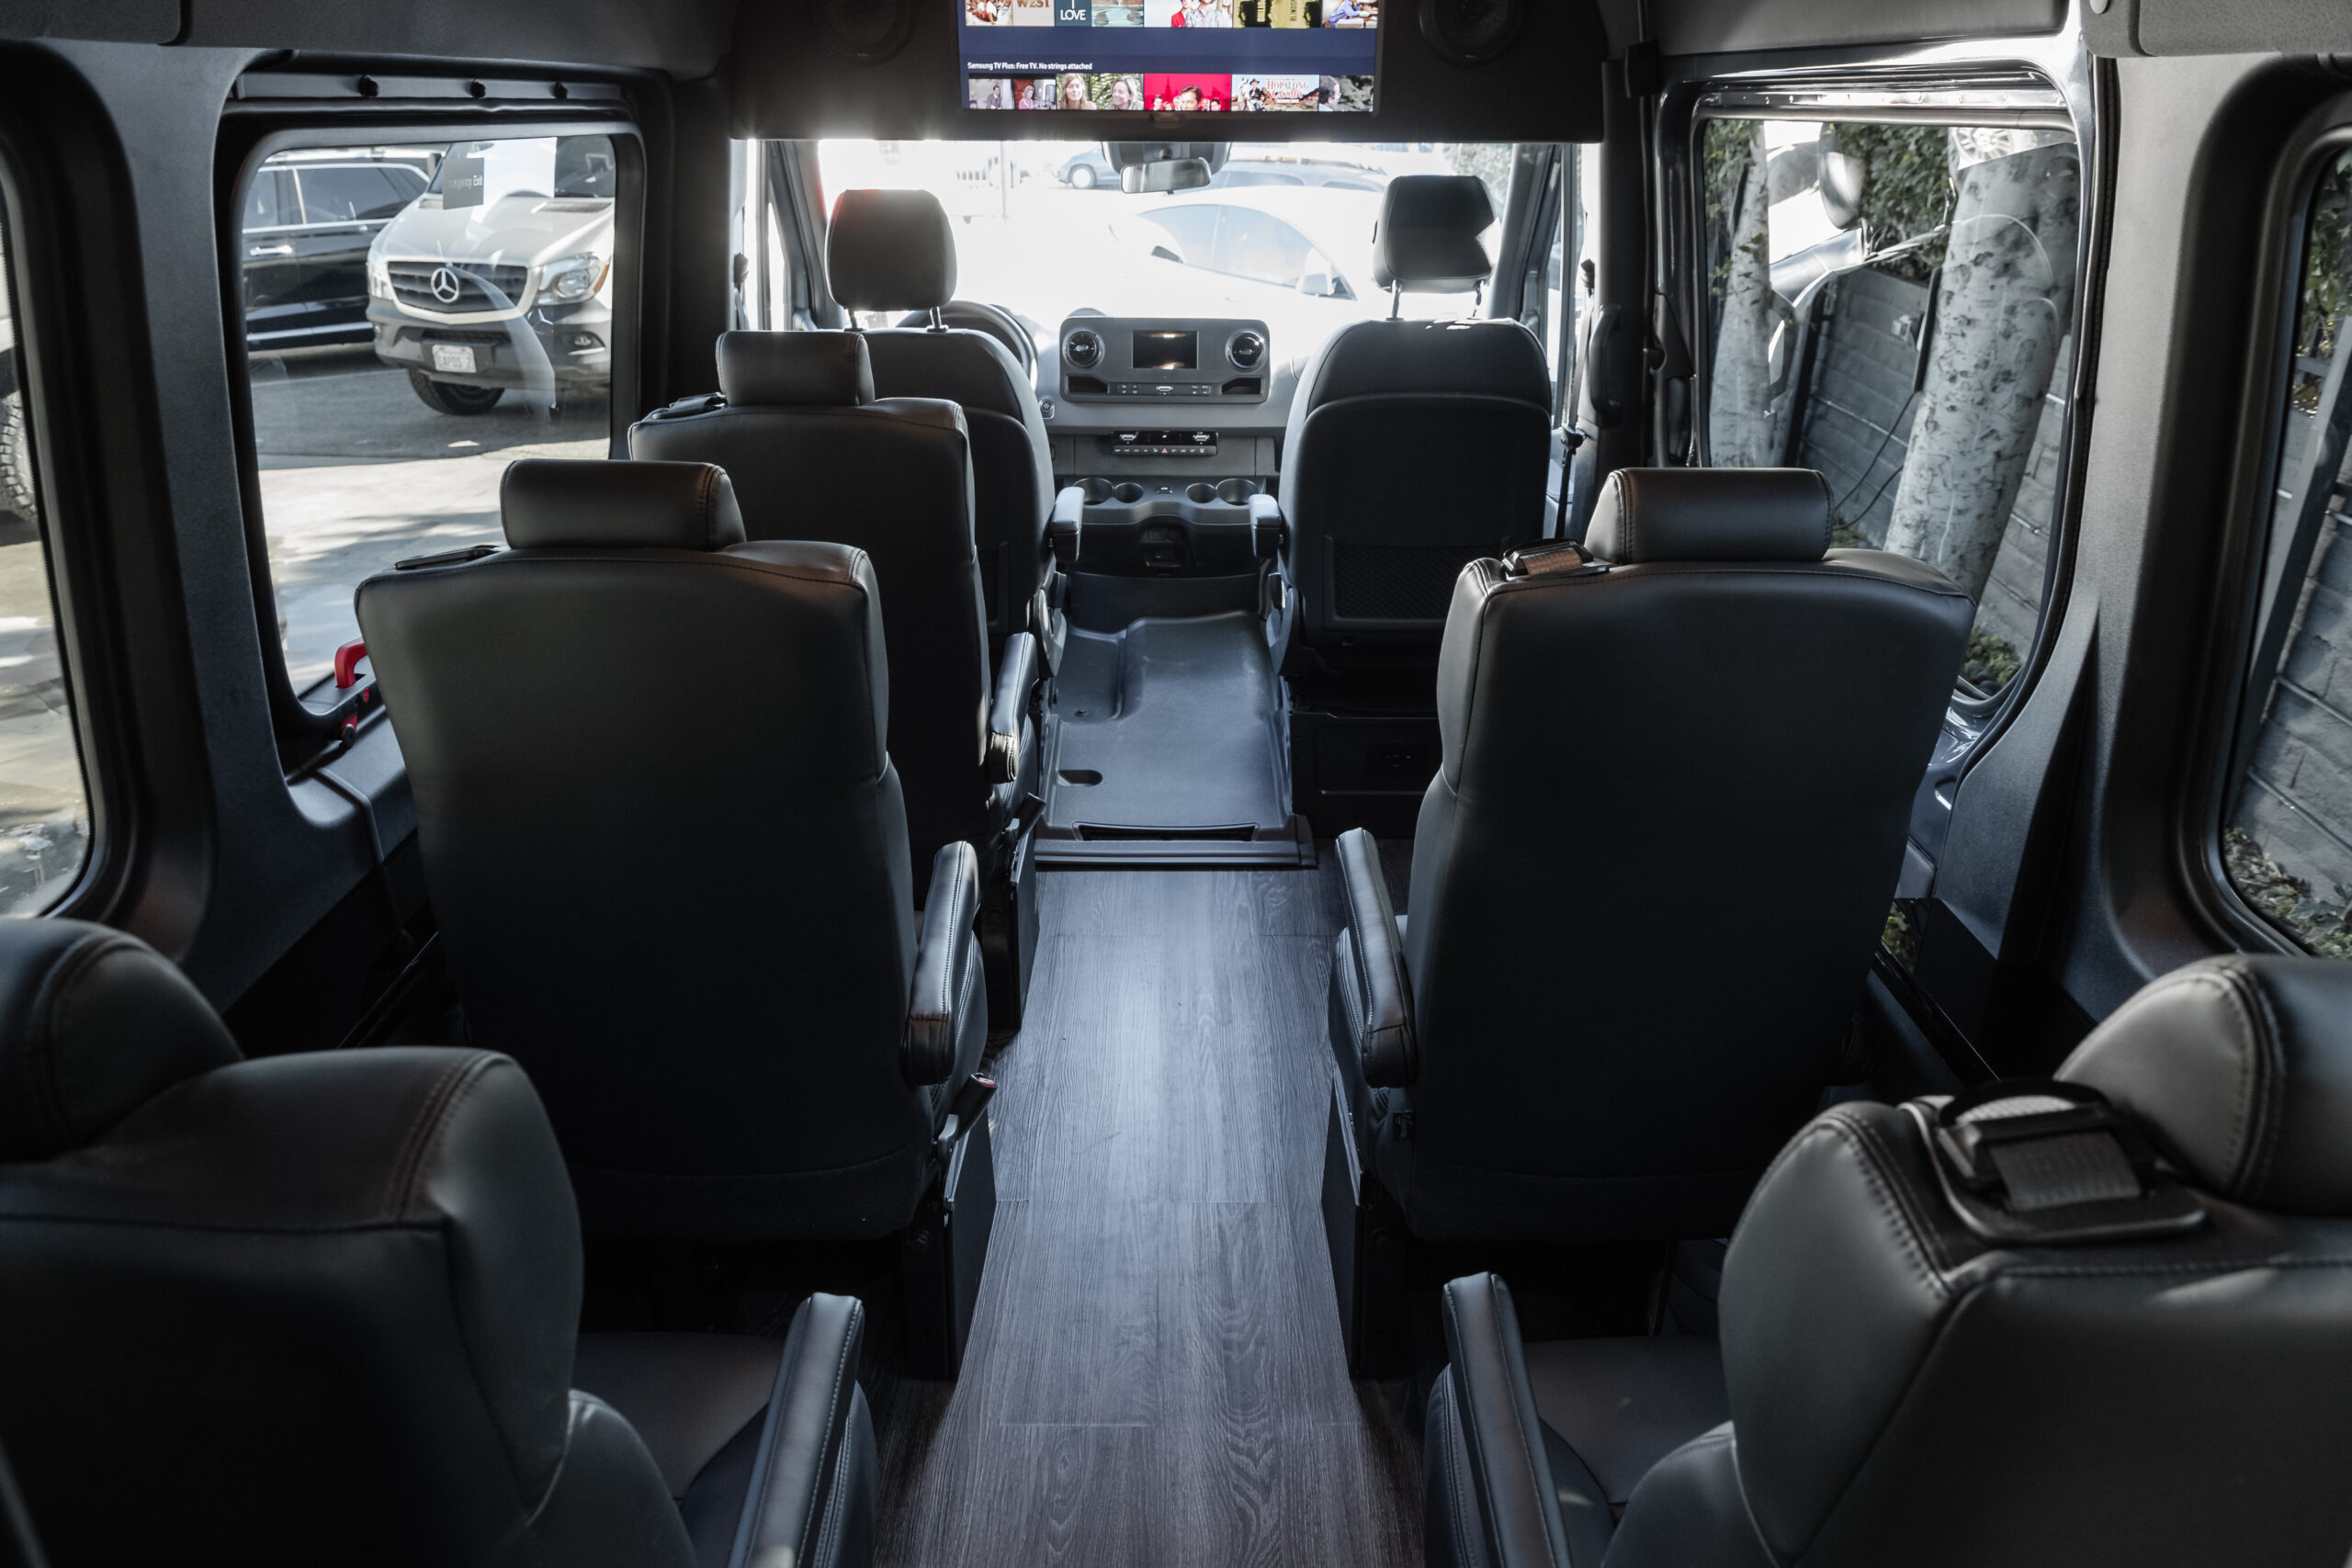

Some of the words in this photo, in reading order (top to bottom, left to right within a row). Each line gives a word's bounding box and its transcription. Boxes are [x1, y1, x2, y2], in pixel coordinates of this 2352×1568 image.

[1059, 9, 1087, 21] LOVE
[967, 62, 994, 71] Samsung
[993, 62, 1001, 70] TV
[1015, 62, 1029, 70] Free
[1038, 62, 1048, 70] No
[1047, 62, 1068, 71] strings
[1067, 62, 1093, 71] attached
